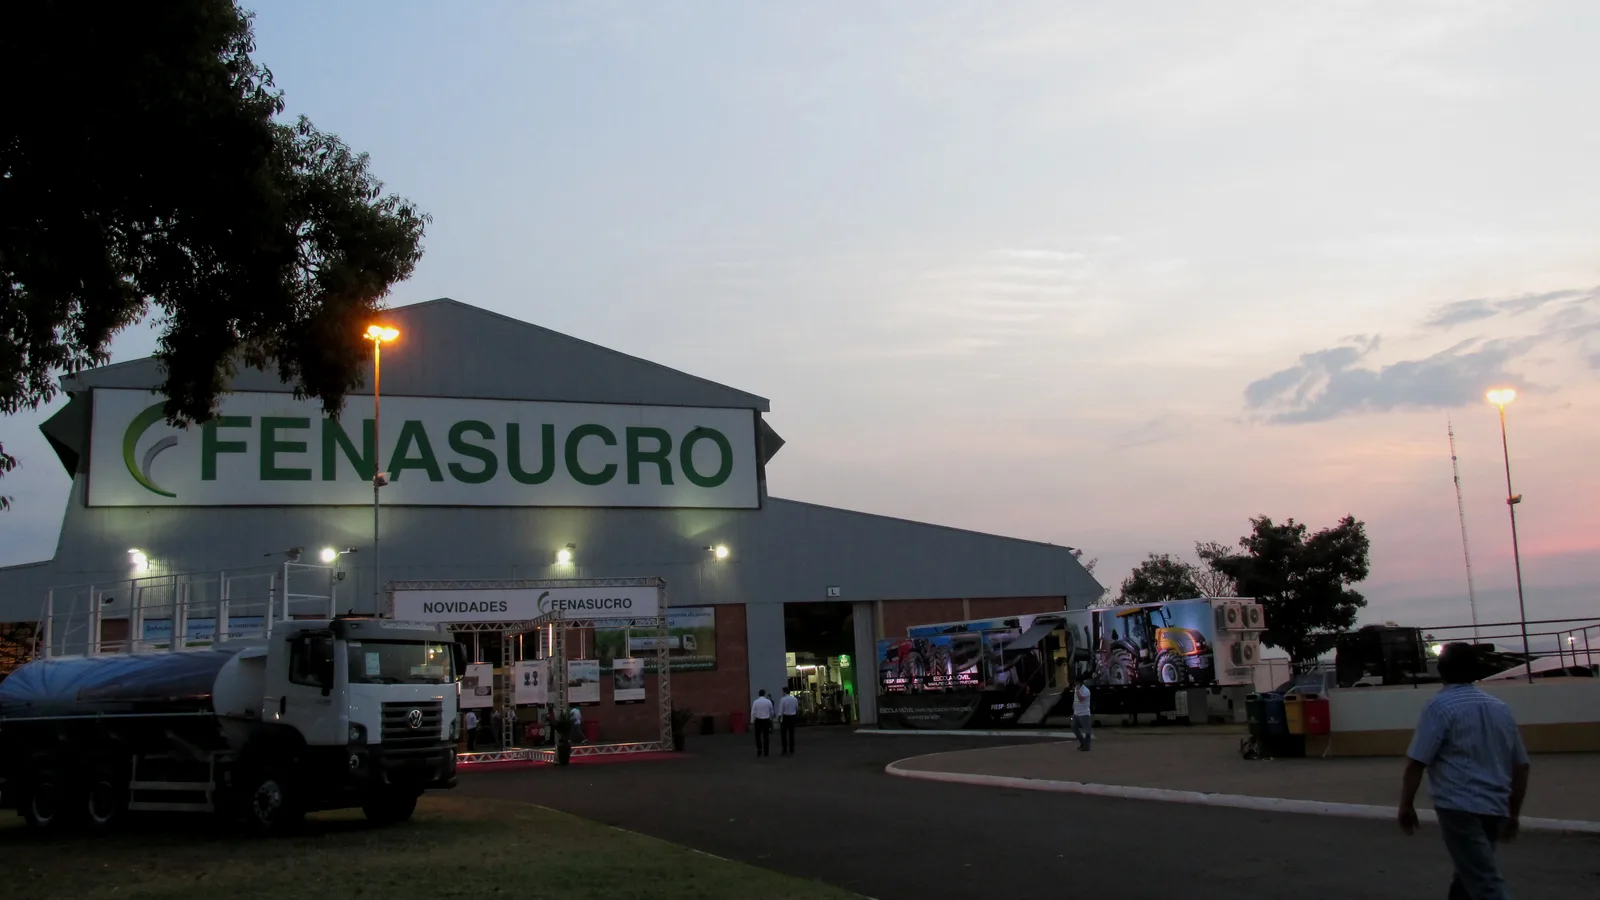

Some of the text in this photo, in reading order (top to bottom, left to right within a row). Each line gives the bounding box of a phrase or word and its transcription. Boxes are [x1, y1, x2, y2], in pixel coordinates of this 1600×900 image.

[200, 414, 733, 488] FENASUCRO
[423, 601, 508, 613] NOVIDADES
[551, 598, 632, 611] FENASUCRO
